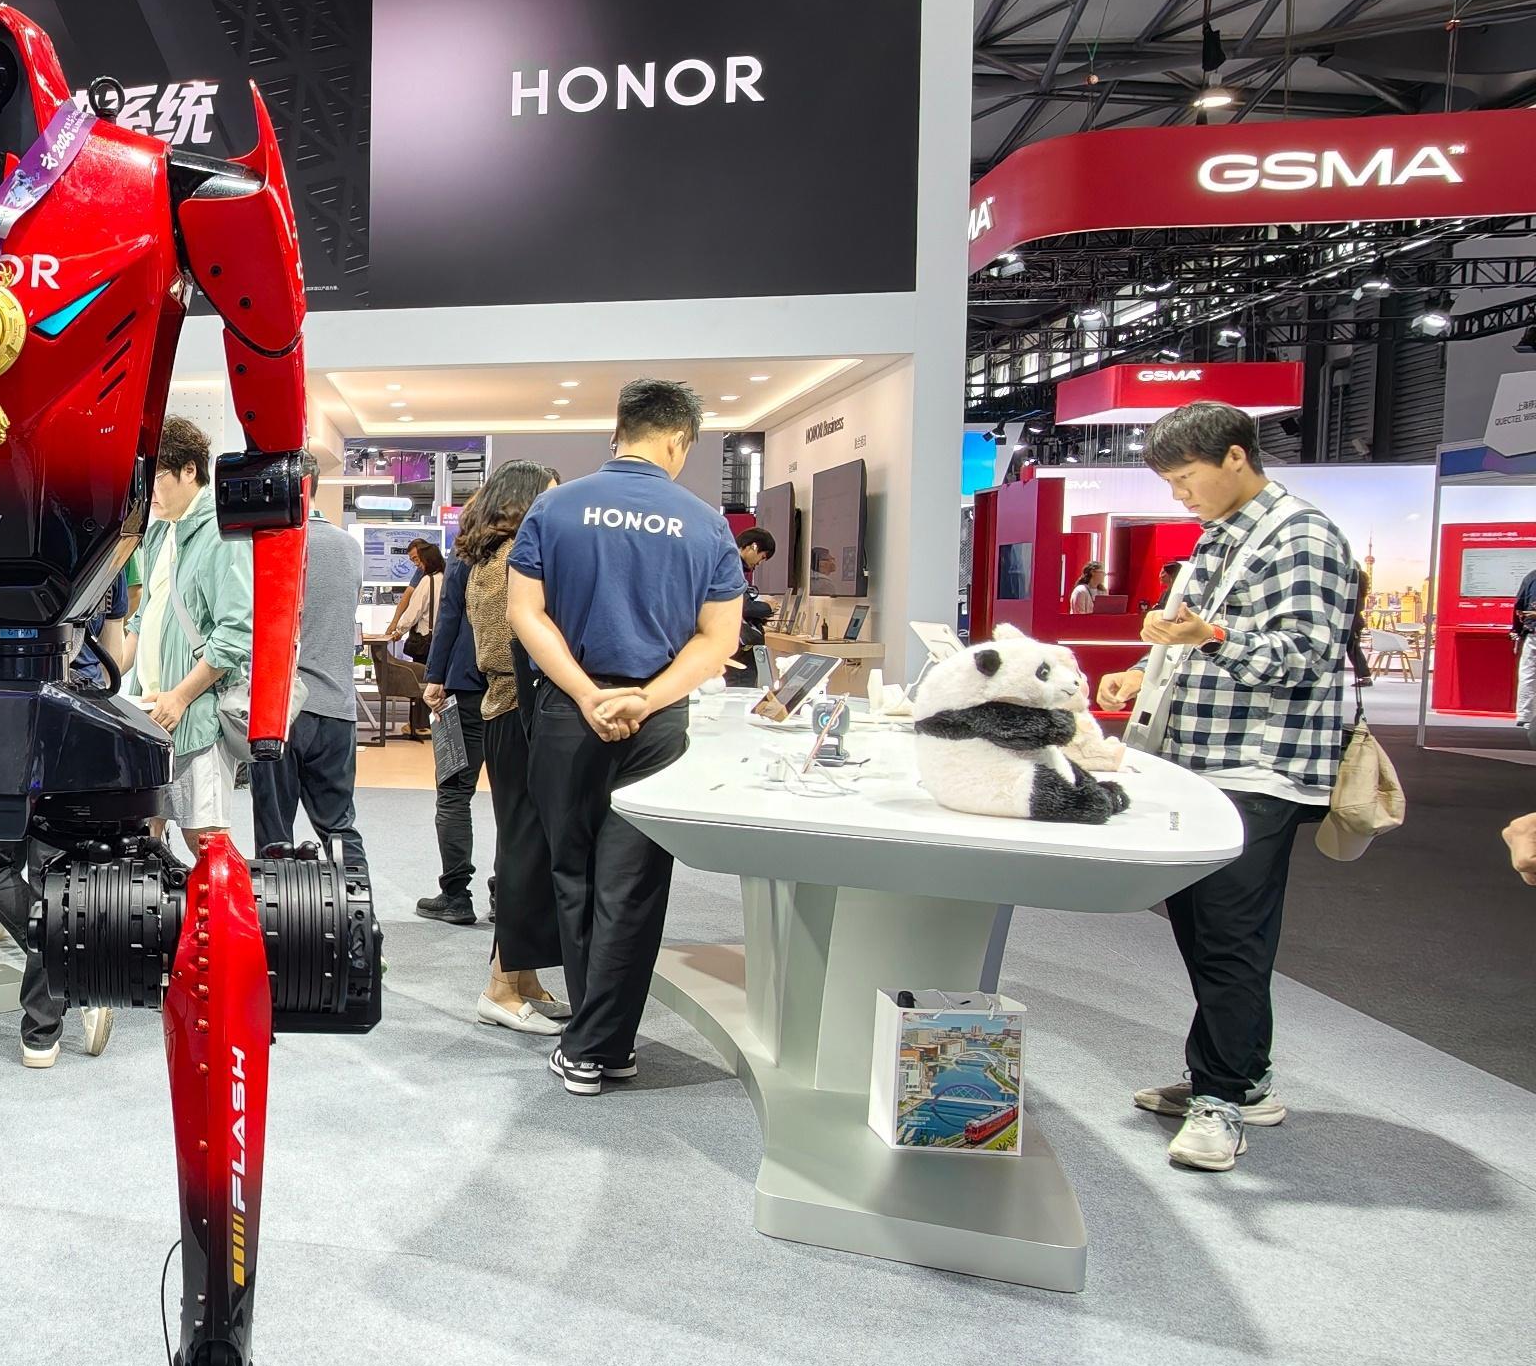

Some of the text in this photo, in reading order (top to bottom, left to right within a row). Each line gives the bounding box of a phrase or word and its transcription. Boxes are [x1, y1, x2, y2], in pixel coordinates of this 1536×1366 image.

[511, 55, 765, 117] HONOR
[583, 506, 684, 538] HONOR
[231, 1045, 247, 1214] FLASH
